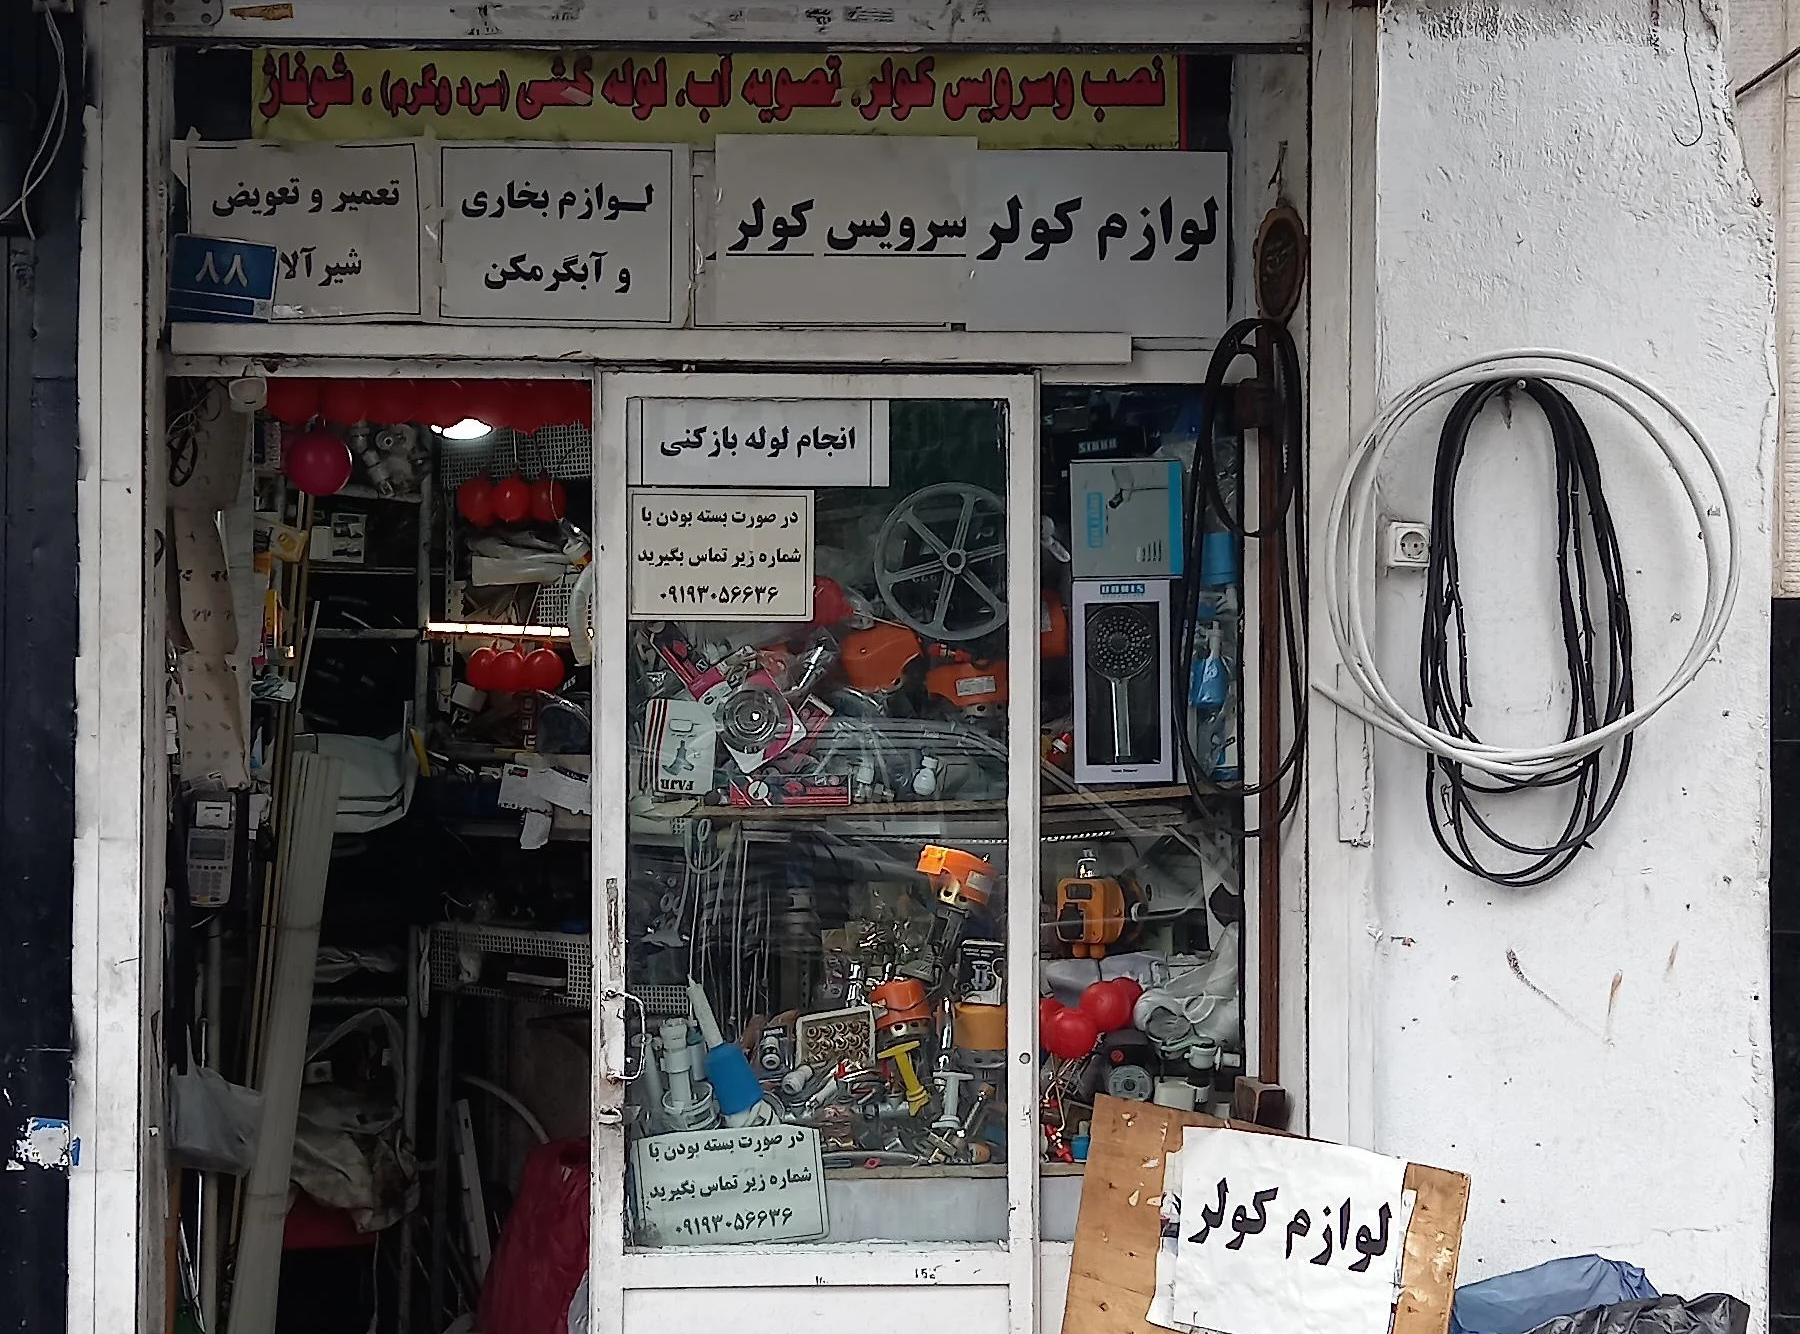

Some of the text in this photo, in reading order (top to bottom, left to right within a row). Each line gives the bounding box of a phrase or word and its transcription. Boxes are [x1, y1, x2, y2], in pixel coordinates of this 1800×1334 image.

[258, 51, 355, 118] شوفاژ
[516, 55, 593, 120] کشی
[601, 57, 668, 120] لوله
[741, 55, 842, 121] تصویه
[1081, 55, 1166, 122] نصب
[212, 177, 400, 218] تعمیر و تعویض
[461, 179, 655, 221] لوازم بخاری
[727, 196, 967, 252] سرویس کولر
[976, 194, 1220, 262] لوازم کولر
[195, 251, 248, 287] ۸۸
[484, 250, 631, 294] و آبگرمکن
[744, 425, 790, 458] لوله
[796, 425, 856, 458] انجام
[641, 507, 799, 529] در صورت بسته بودن با
[637, 547, 801, 568] شماره زیر تماس بگیرید
[660, 585, 779, 604] ۰۹۱۹۳۰۵۶۶۳۶
[648, 1130, 805, 1162] در صورت بسته بودن با
[649, 1166, 812, 1201] شماره زیر تماس بگیرید
[675, 1207, 793, 1236] ۰۹۱۹۳۰۵۶۶۳۶
[1187, 1177, 1393, 1273] لوازم کولر
